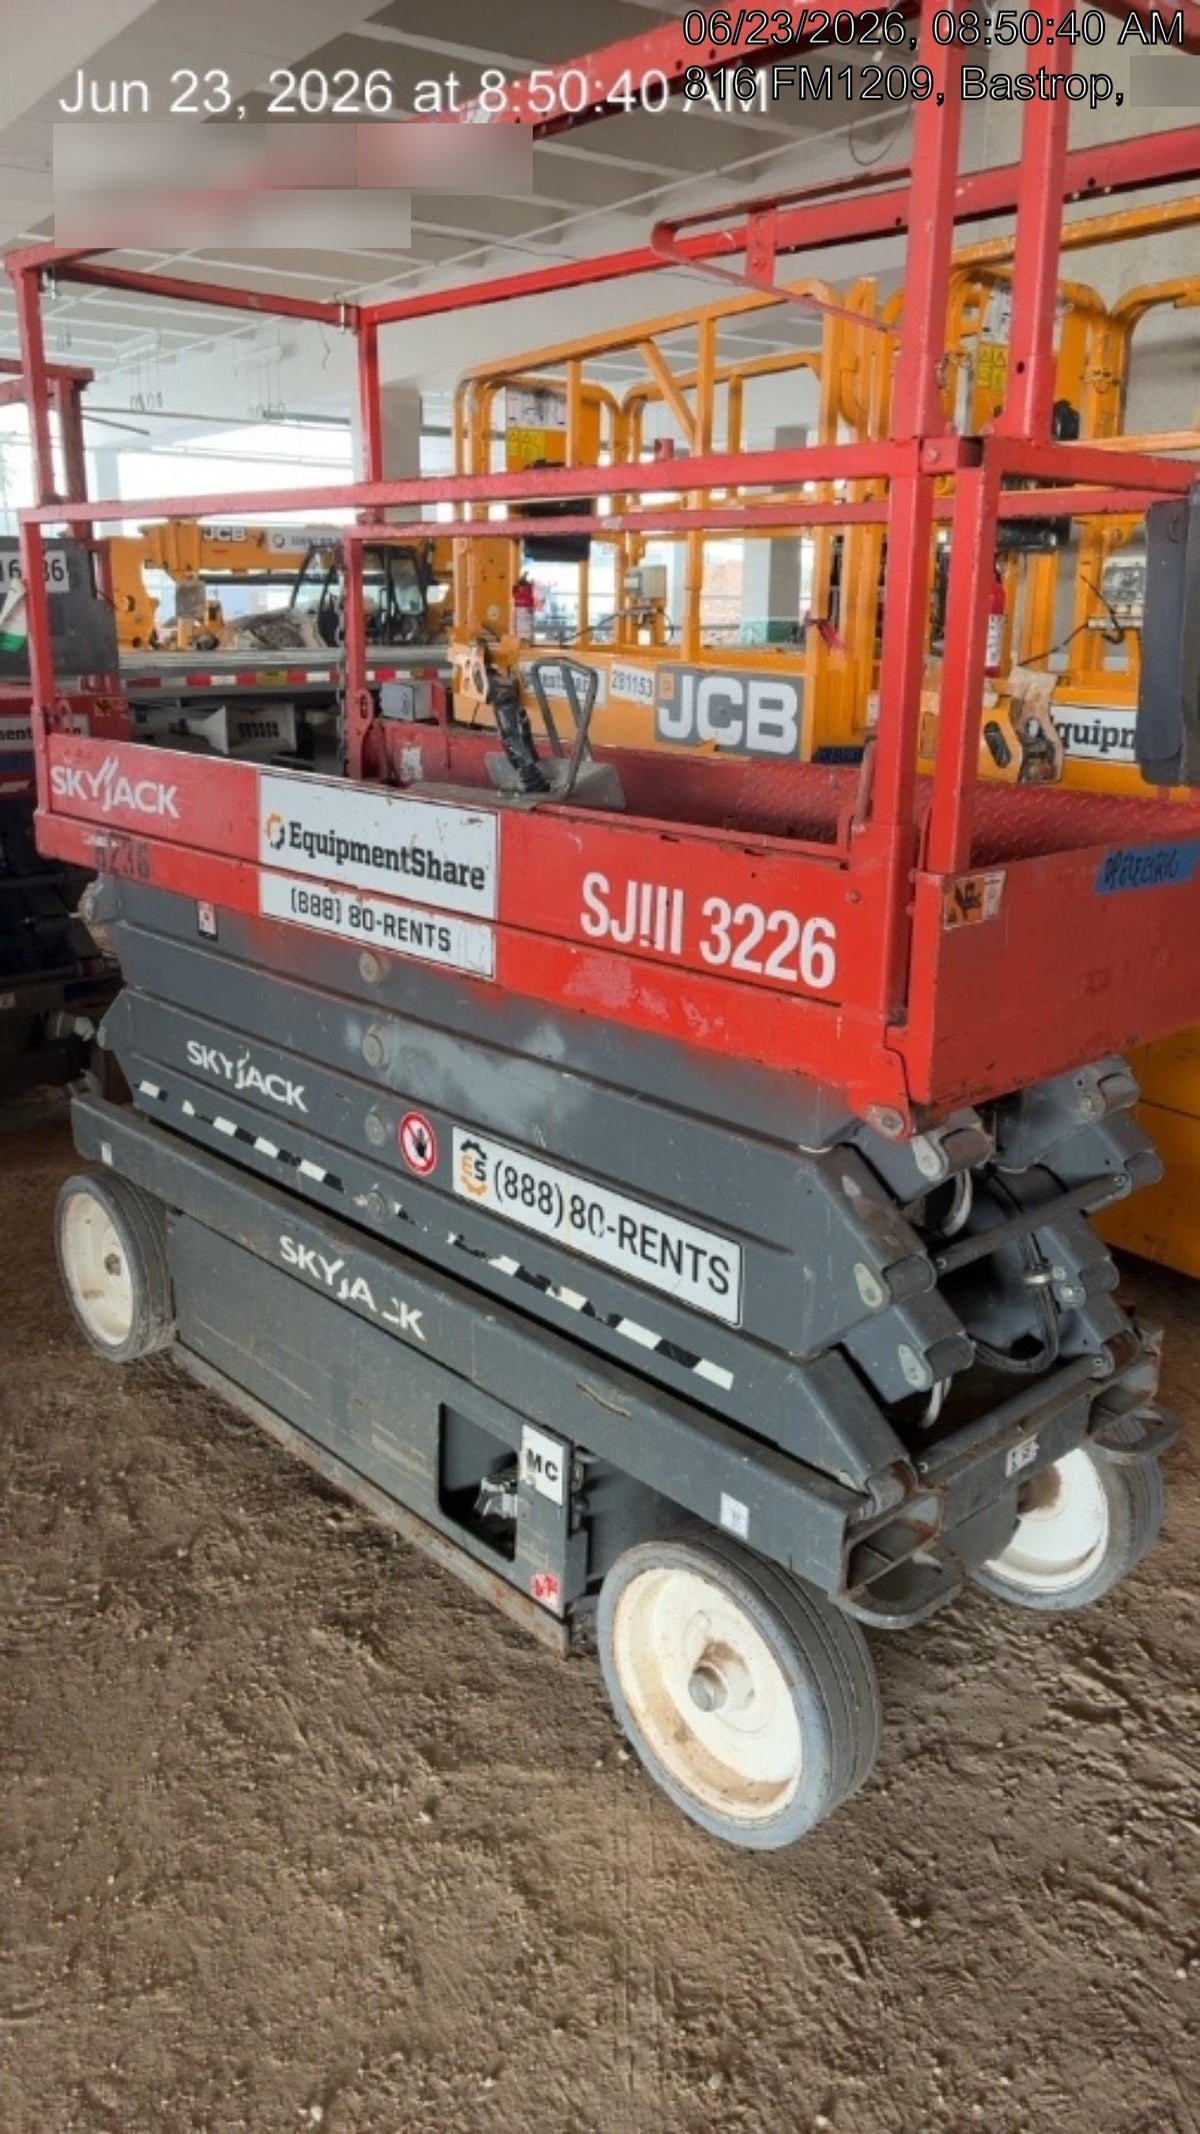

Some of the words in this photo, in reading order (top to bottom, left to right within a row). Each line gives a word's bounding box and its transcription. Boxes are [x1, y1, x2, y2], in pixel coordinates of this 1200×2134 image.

[659, 675, 798, 754] JCB
[50, 756, 180, 818] SKYJACK
[288, 820, 486, 890] EquipmentShare
[291, 887, 341, 924] (888)
[348, 904, 452, 952] 80-RENTS
[699, 897, 836, 989] 3226
[186, 1040, 309, 1113] SKYJACK
